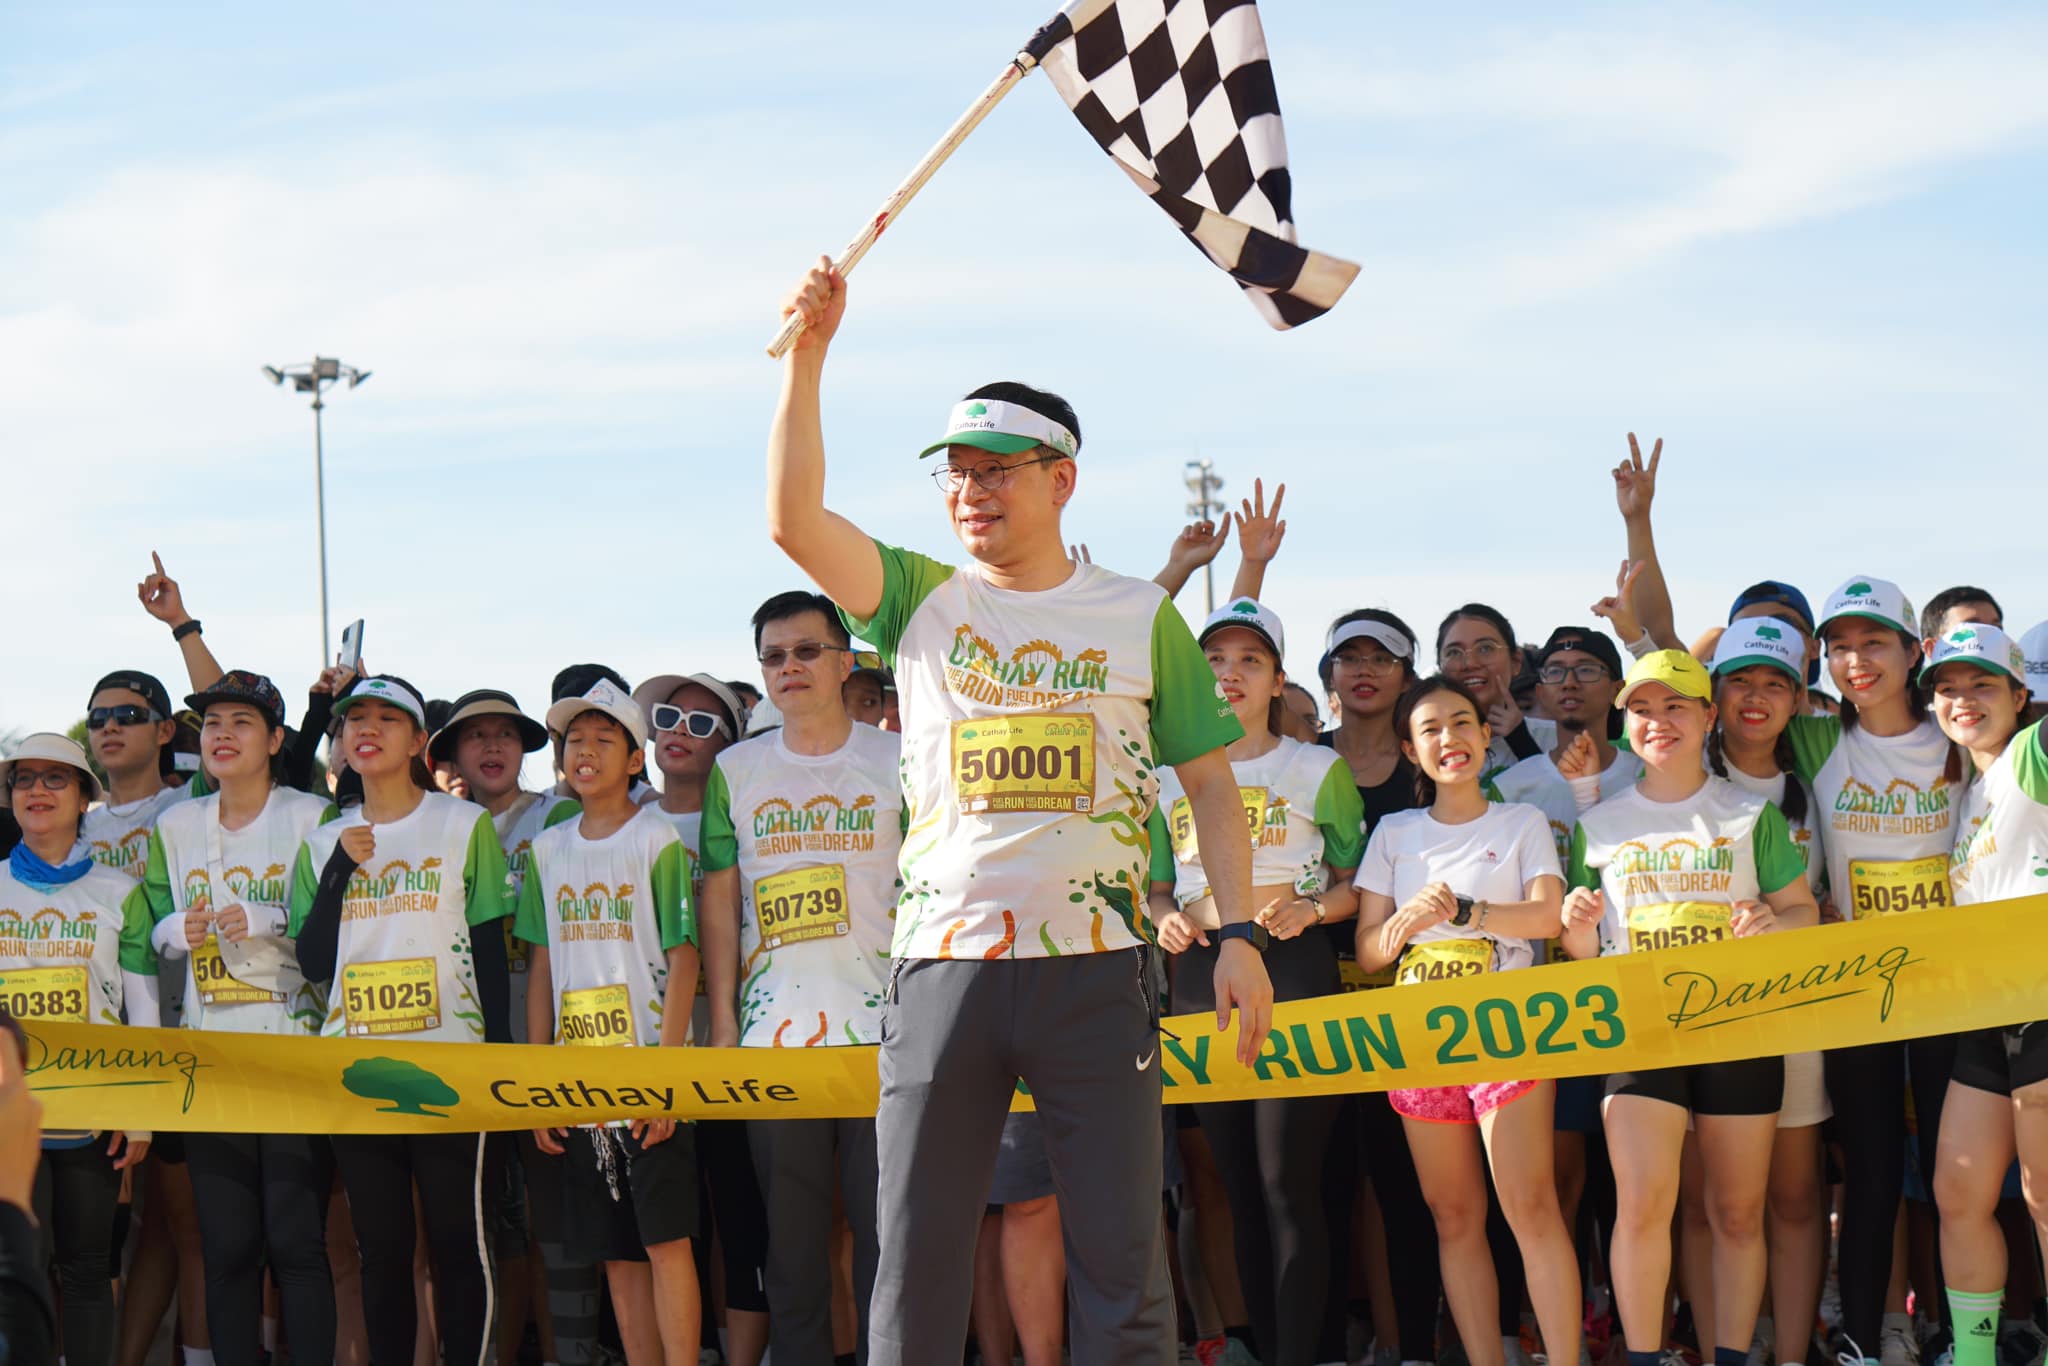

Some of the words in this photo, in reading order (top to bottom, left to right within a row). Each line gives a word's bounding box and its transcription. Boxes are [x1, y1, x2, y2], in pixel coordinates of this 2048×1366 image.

[980, 420, 995, 429] Life
[1834, 599, 1864, 609] Cathay
[1865, 598, 1881, 608] Life
[1744, 640, 1774, 651] Cathay
[1775, 644, 1789, 655] Life
[1053, 659, 1109, 692] RUN
[960, 673, 1003, 706] RUN
[1007, 688, 1031, 703] FUEL
[982, 727, 1007, 737] Cathay
[1009, 727, 1024, 735] Life
[960, 745, 1082, 794] 50001
[1004, 797, 1024, 809] RUN
[1037, 797, 1072, 810] DREAM
[1834, 790, 1908, 815] CATHAY
[1916, 788, 1949, 814] RUN
[754, 808, 830, 838] CATHAY
[836, 808, 876, 832] RUN
[1848, 814, 1880, 832] RUN
[1903, 811, 1949, 834] DREAM
[771, 836, 801, 855] RUN
[823, 833, 874, 852] DREAM
[1694, 848, 1733, 873] RUN
[247, 879, 285, 902] RUN
[405, 870, 441, 894] RUN
[1627, 875, 1659, 896] RUN
[1680, 873, 1731, 893] DREAM
[351, 902, 377, 920] RUN
[394, 894, 438, 913] DREAM
[761, 887, 842, 926] 50739
[1857, 880, 1946, 913] 50544
[607, 898, 633, 922] RUN
[60, 921, 97, 941] RUN
[599, 922, 634, 944] DREAM
[0, 940, 28, 958] RUN
[47, 940, 95, 959] DREAM
[348, 981, 433, 1012] 51025
[1663, 945, 1926, 1030] Danang
[562, 1007, 628, 1040] 50606
[1254, 1013, 1407, 1081] RUN
[1426, 984, 1626, 1064] 2023
[490, 1079, 675, 1111] Cathay
[692, 1078, 799, 1105] Life
